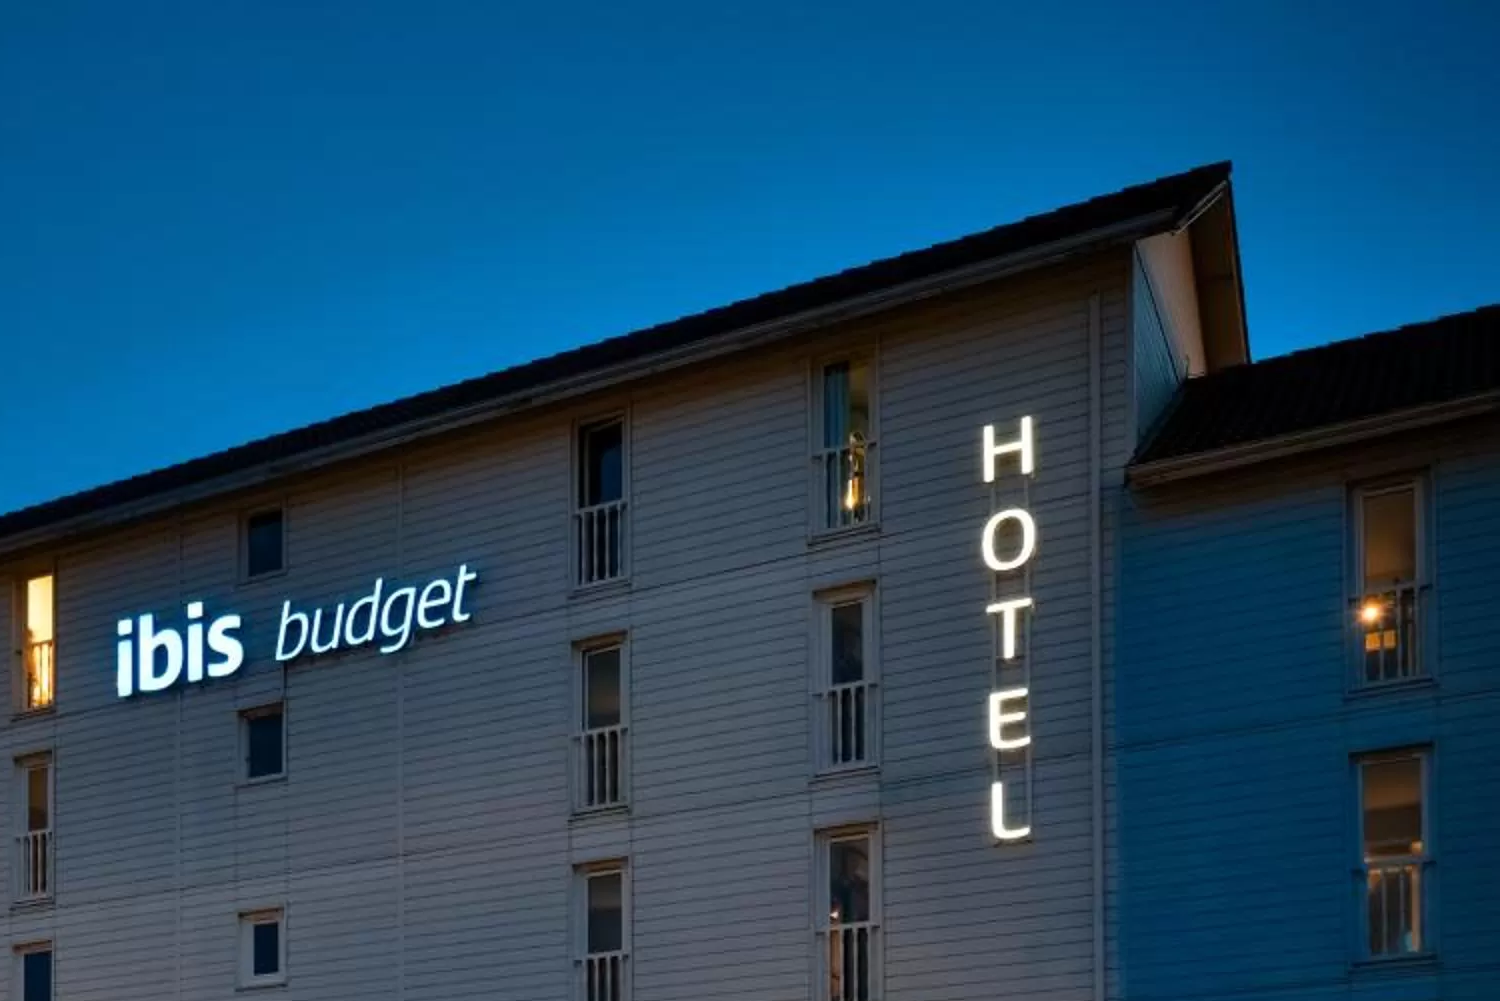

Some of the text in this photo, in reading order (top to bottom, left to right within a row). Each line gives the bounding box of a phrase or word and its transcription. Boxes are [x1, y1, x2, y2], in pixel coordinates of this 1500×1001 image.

[116, 564, 477, 698] ibis budget
[980, 415, 1037, 840] HOTEL
